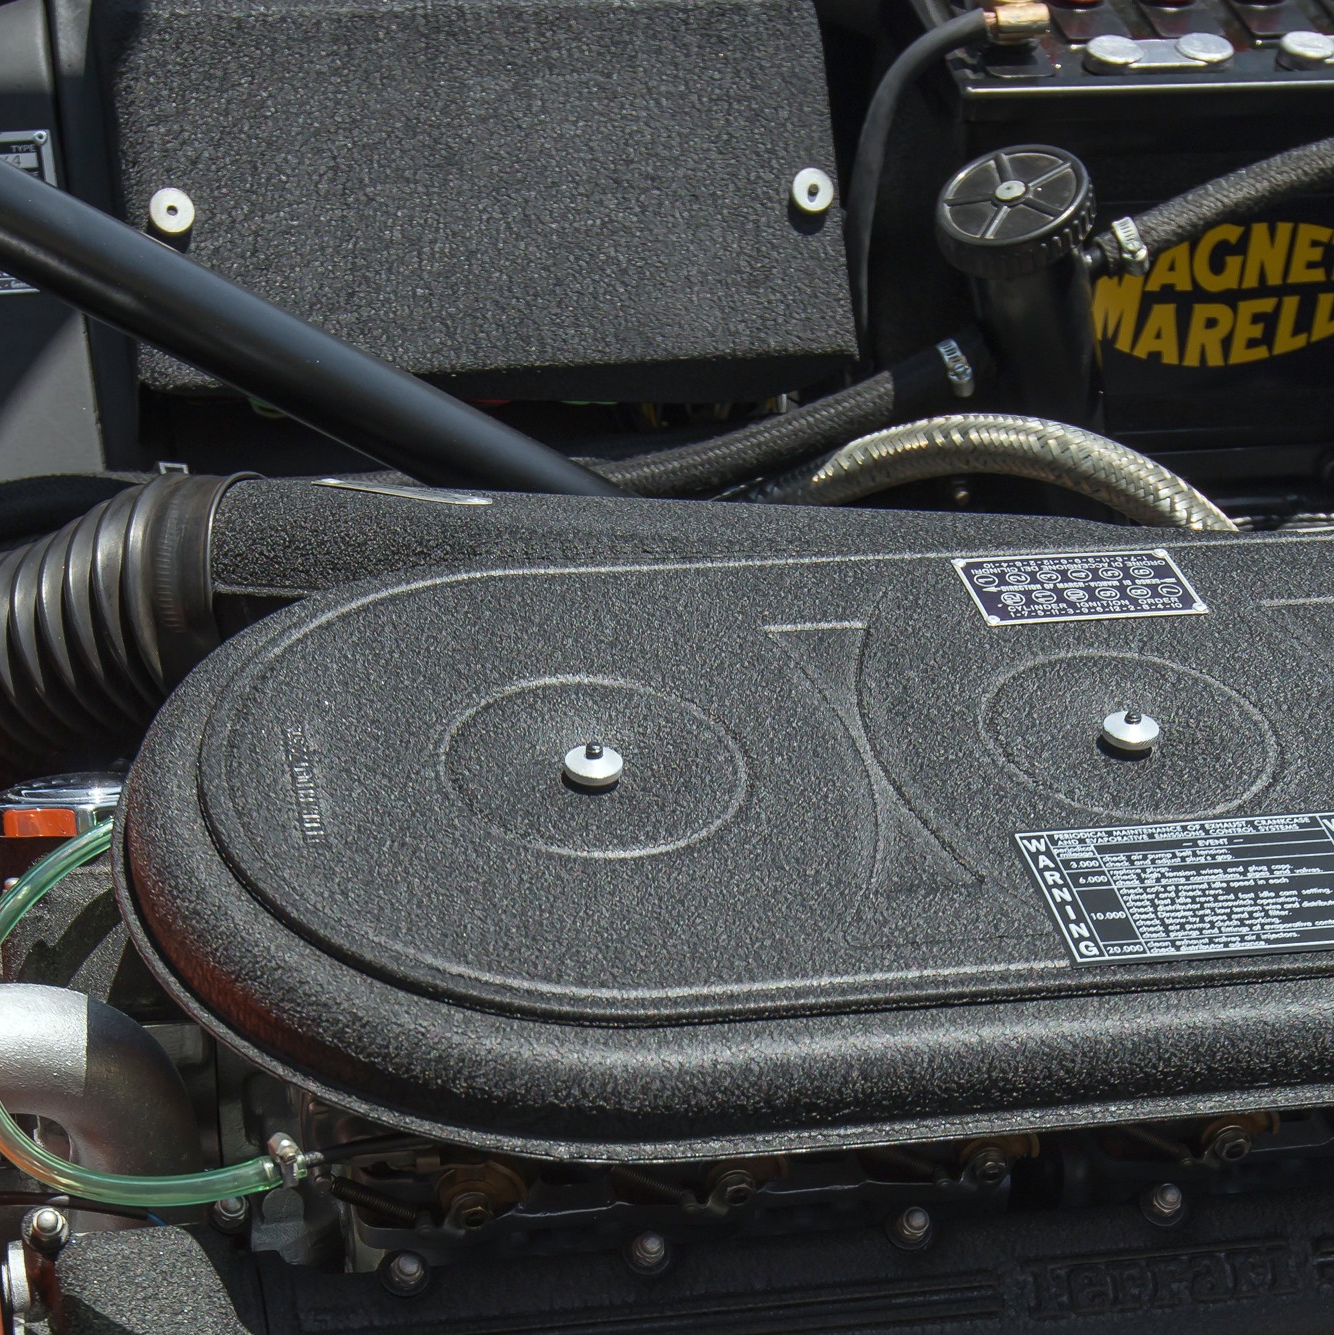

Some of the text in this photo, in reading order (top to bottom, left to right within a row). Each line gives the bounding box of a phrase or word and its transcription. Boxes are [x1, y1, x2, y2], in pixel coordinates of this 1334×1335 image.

[10, 144, 37, 153] TYPE
[1000, 584, 1042, 592] DIRECTION
[1008, 597, 1179, 612] CYLINDER IGNITION ORDER
[1054, 831, 1108, 840] PERIODICAL
[1113, 826, 1182, 836] MAINTENANCE
[1204, 822, 1250, 830] EXHAUST,
[1254, 818, 1310, 827] CRANKCASE
[1085, 834, 1149, 844] EVAPORATIVE
[1154, 830, 1205, 839] EMISSIONS
[1209, 827, 1257, 836] CONTROL
[1258, 824, 1299, 832] SYSTEMS
[1197, 838, 1228, 846] EVENT
[1070, 860, 1099, 868] 3.000
[1079, 876, 1108, 884] 6.000
[1023, 838, 1100, 957] WARNING
[1091, 911, 1126, 920] 10.000
[1107, 945, 1143, 954] 20.000
